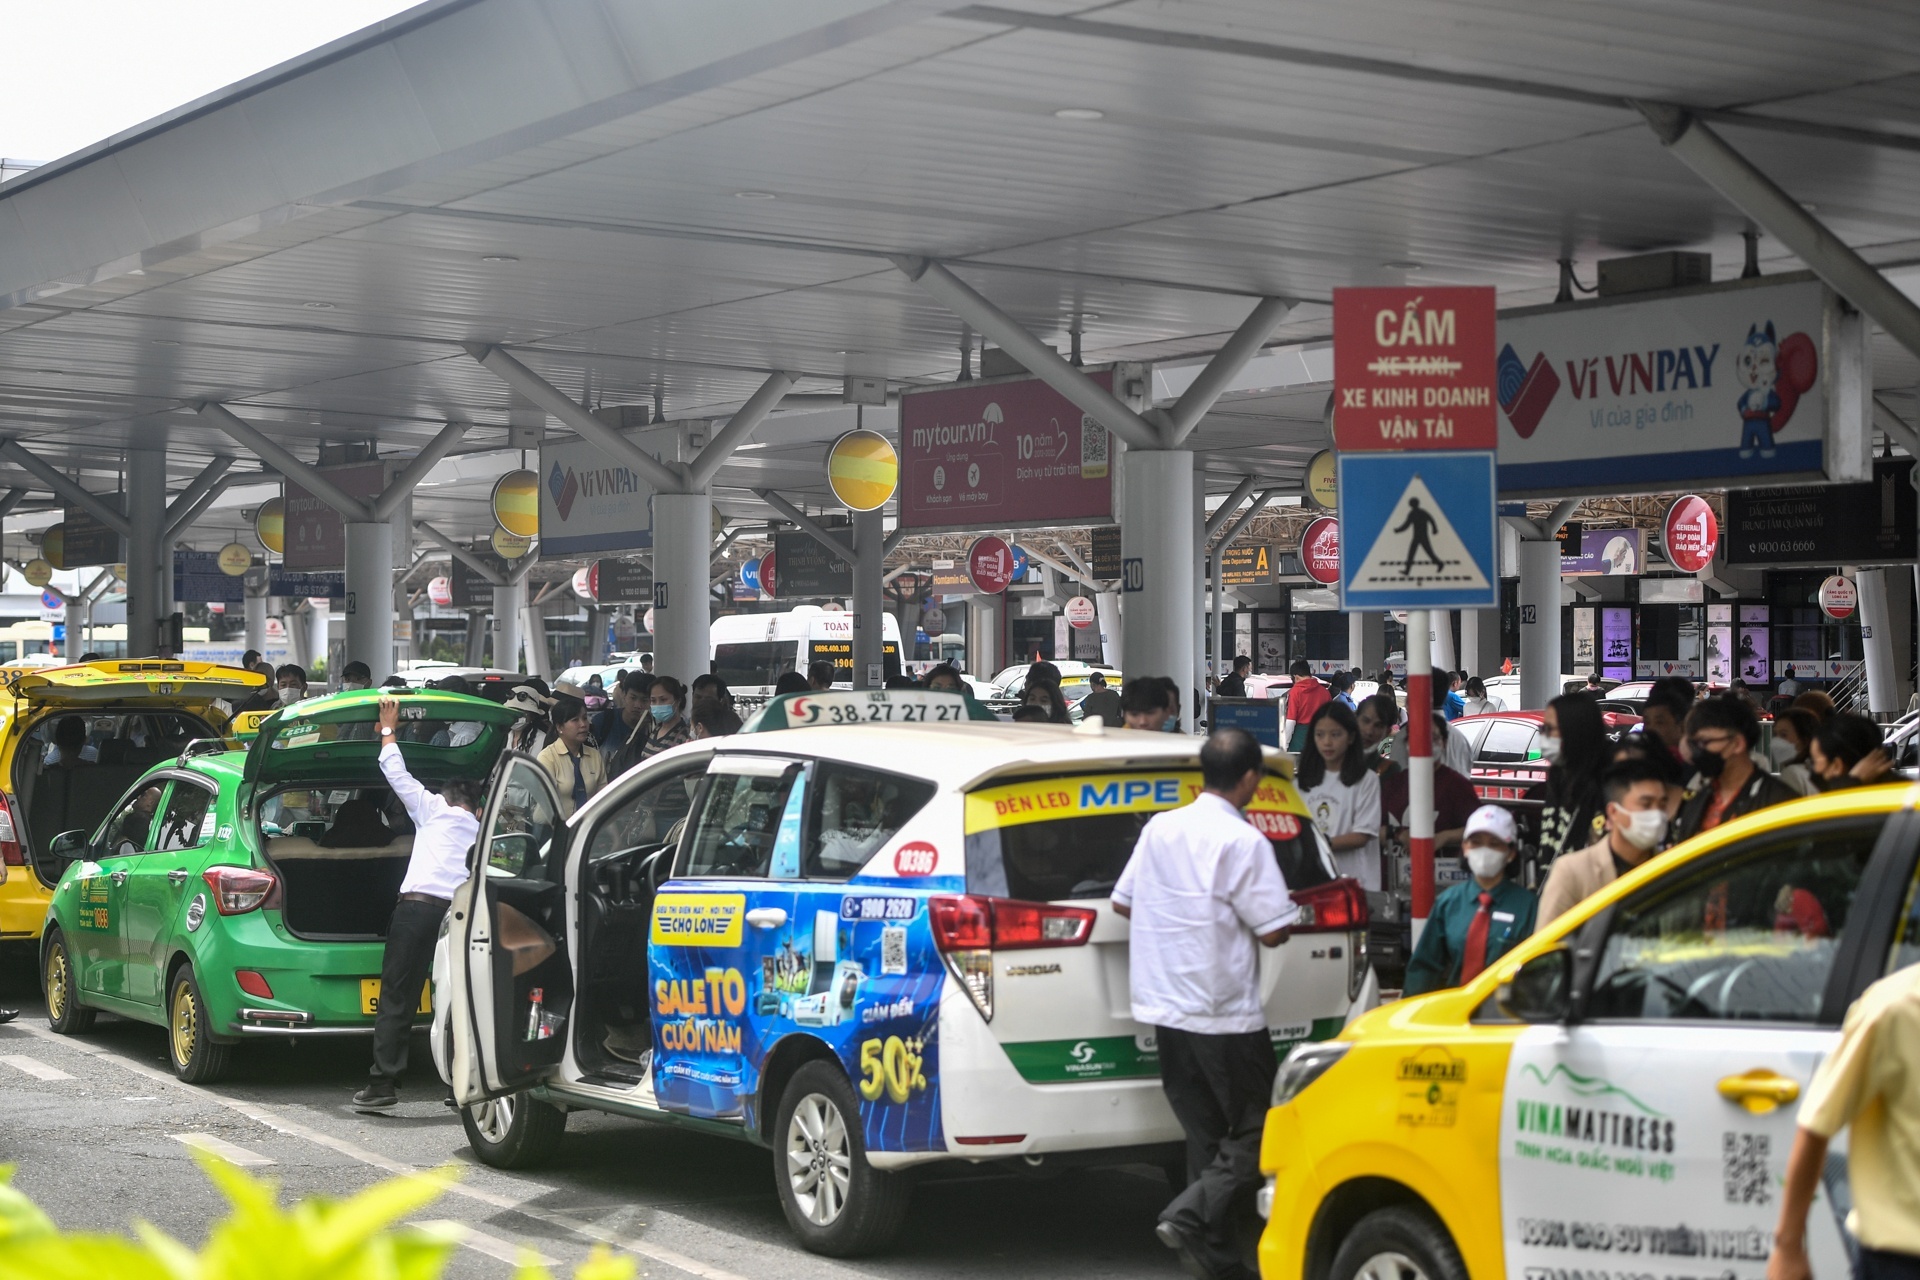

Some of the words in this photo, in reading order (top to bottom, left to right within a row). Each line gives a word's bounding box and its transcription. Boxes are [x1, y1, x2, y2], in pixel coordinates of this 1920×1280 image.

[1375, 296, 1455, 346] CẤM
[1566, 357, 1599, 400] Ví
[1605, 344, 1720, 396] VNPAY
[1342, 388, 1366, 408] XE
[1372, 388, 1417, 407] KINH
[1424, 387, 1490, 406] DOANH
[1379, 415, 1418, 443] VẬN
[1424, 413, 1453, 438] TẢI
[1607, 404, 1631, 428] của
[1635, 407, 1657, 430] gia
[1661, 400, 1693, 422] đình
[913, 421, 986, 453] mytour.vn
[1016, 434, 1033, 460] 10
[1034, 435, 1053, 447] năm
[1016, 467, 1032, 482] Dịch
[1033, 469, 1042, 480] vụ
[1053, 464, 1067, 477] trái
[1257, 547, 1268, 570] A
[1758, 542, 1778, 553] 1900
[1780, 541, 1791, 552] 63
[1793, 540, 1815, 551] 6666
[834, 658, 854, 668] 1900
[829, 704, 893, 723] 38.27
[902, 704, 927, 721] 27
[935, 704, 962, 721] 27
[995, 795, 1034, 816] ĐÈN
[1037, 791, 1070, 809] LED
[1079, 779, 1181, 809] MPE
[861, 898, 885, 918] 1900
[656, 979, 707, 1016] SALE
[705, 967, 746, 1016] TO
[704, 1019, 741, 1053] NĂM
